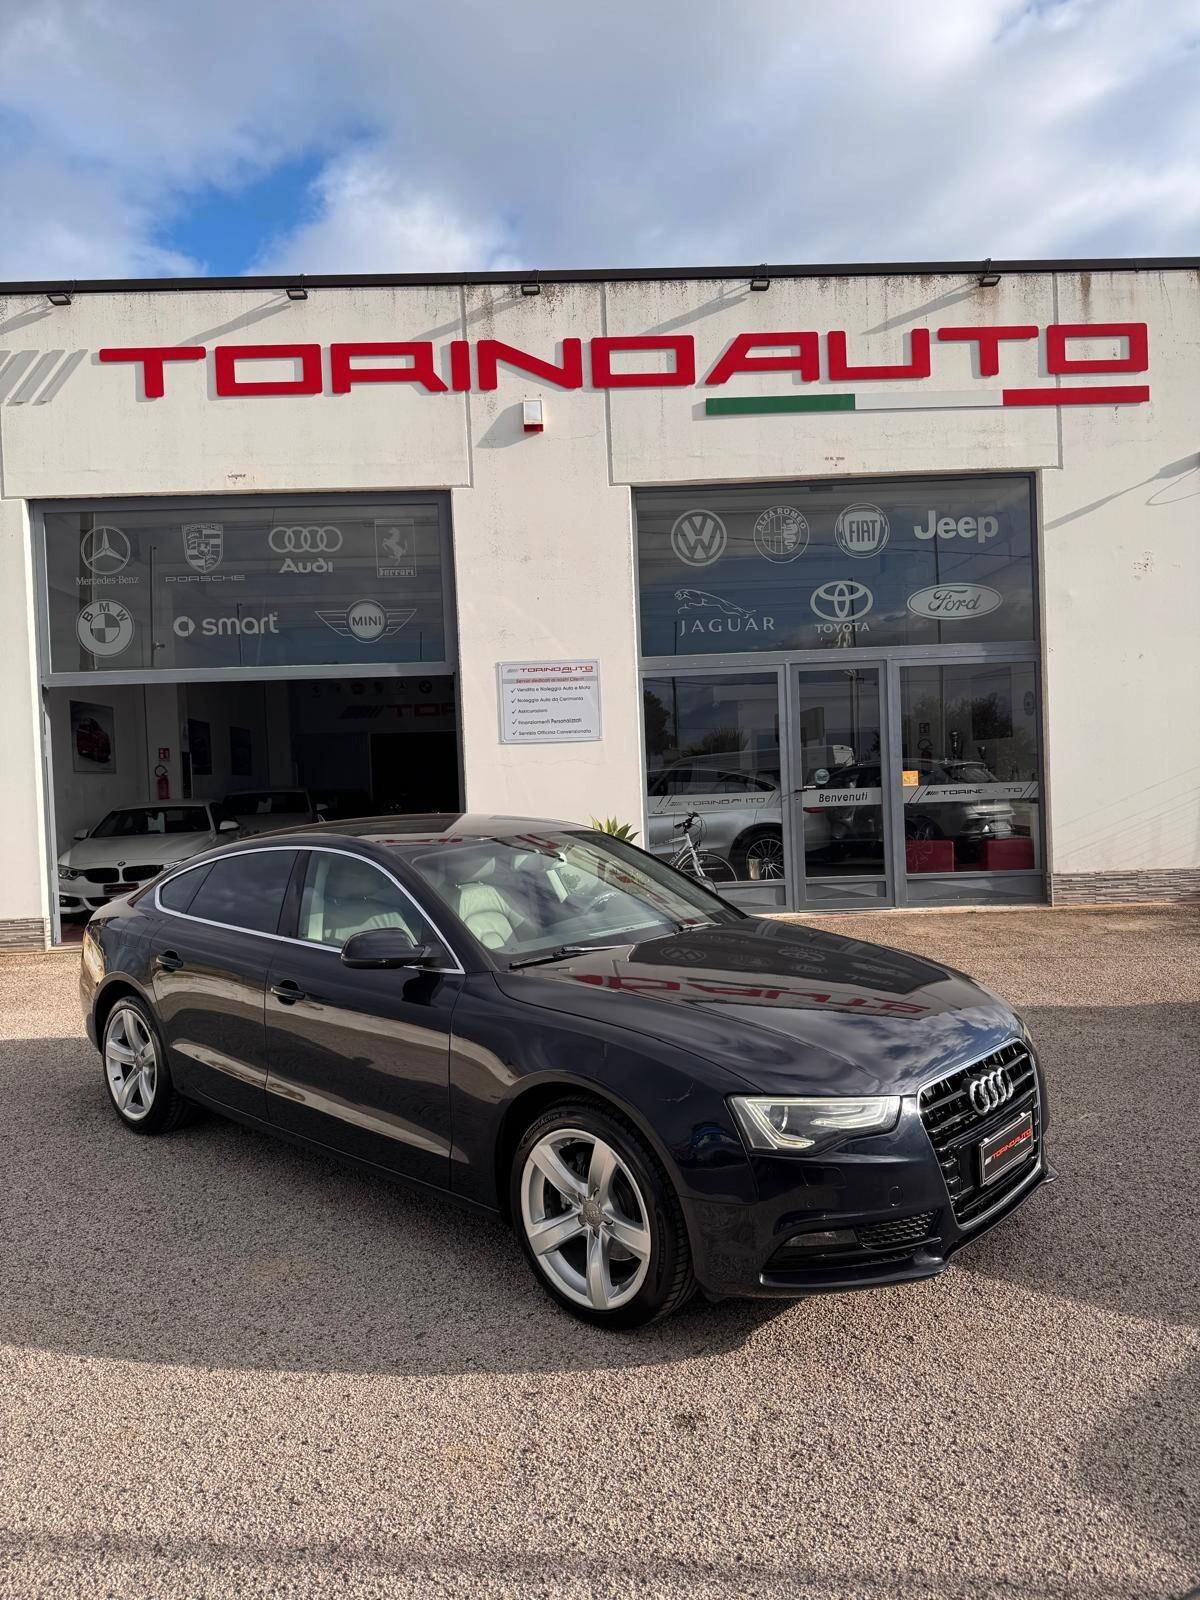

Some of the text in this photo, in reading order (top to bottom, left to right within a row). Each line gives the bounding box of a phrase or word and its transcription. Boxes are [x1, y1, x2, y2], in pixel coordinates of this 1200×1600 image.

[99, 323, 1149, 398] TORINOAUTO
[757, 507, 807, 530] ALFA ROMEO
[913, 510, 999, 543] Jeep
[848, 519, 878, 543] FIAT
[279, 558, 334, 573] Audi
[379, 567, 415, 576] Ferrari
[76, 575, 140, 586] Mercedes-Benz
[928, 589, 981, 611] Ford
[82, 602, 130, 623] BMW
[351, 616, 382, 626] MINI
[202, 612, 279, 635] smart
[679, 617, 775, 636] JAGUAR
[815, 622, 870, 633] TOYOTA
[818, 791, 868, 803] Benvenuti
